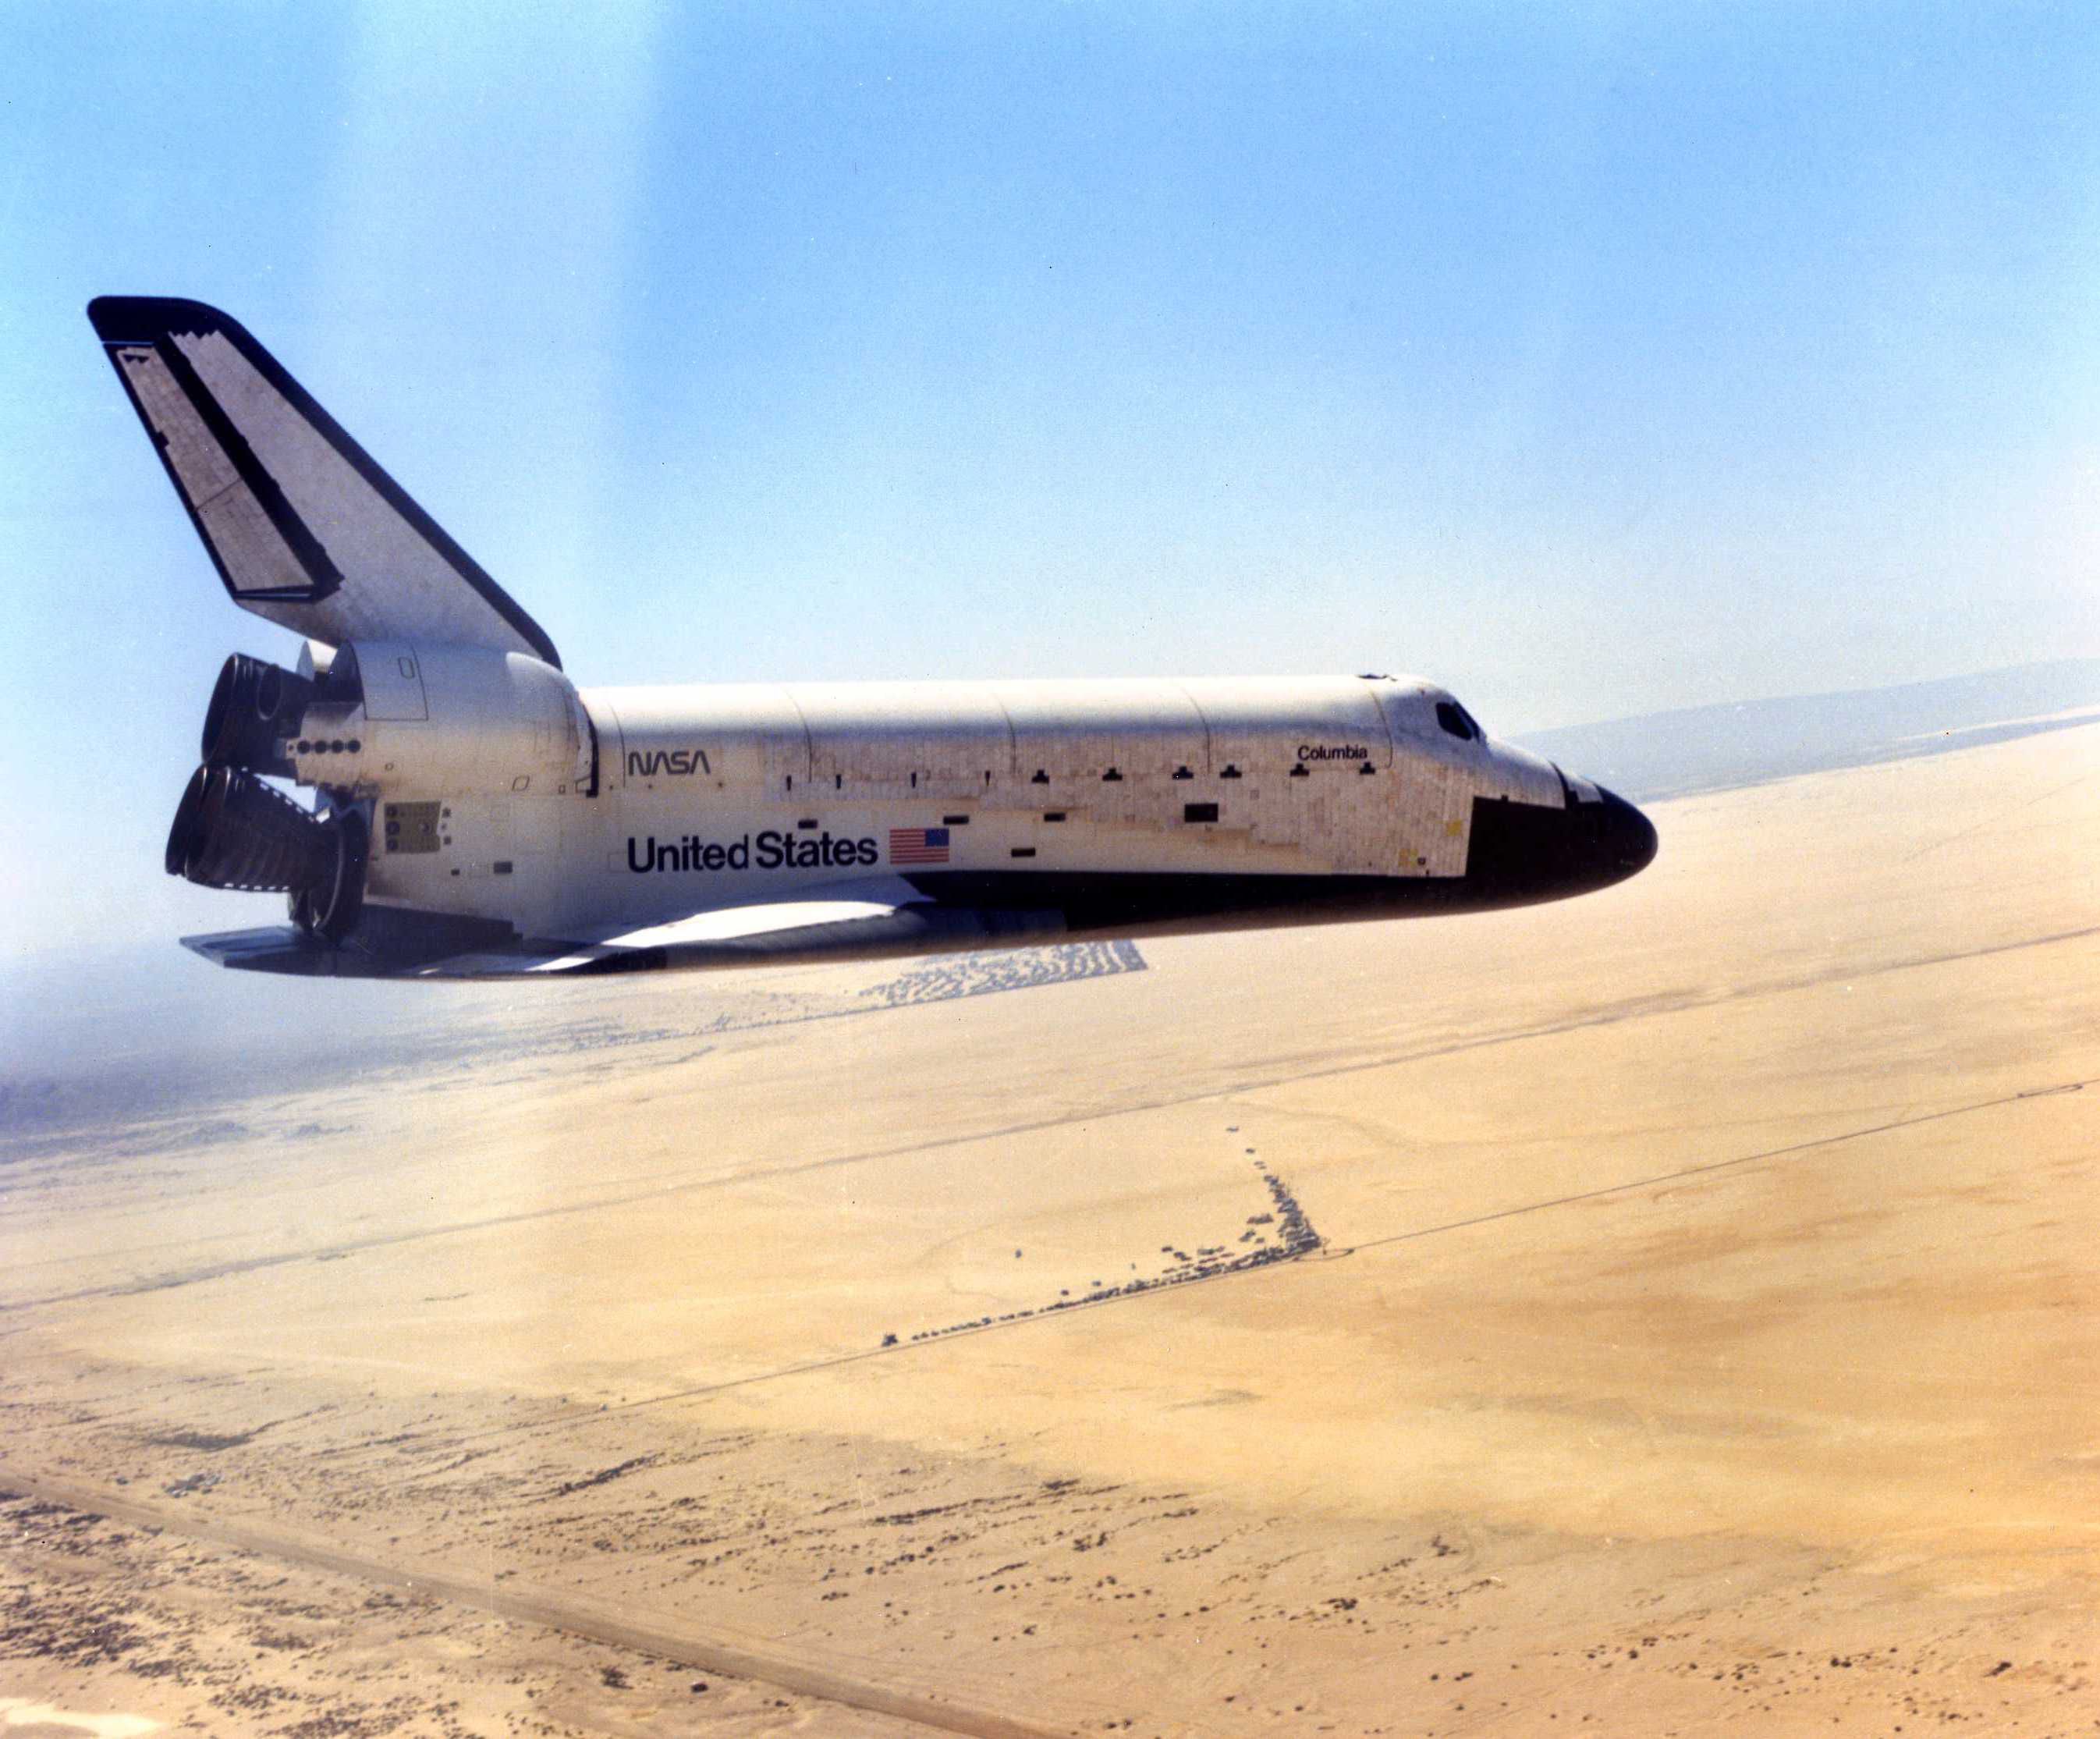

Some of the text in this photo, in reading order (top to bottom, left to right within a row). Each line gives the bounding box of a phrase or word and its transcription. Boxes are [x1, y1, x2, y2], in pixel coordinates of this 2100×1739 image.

[628, 750, 711, 775] NASA
[1298, 745, 1367, 761] Columbia
[628, 831, 878, 872] United States
